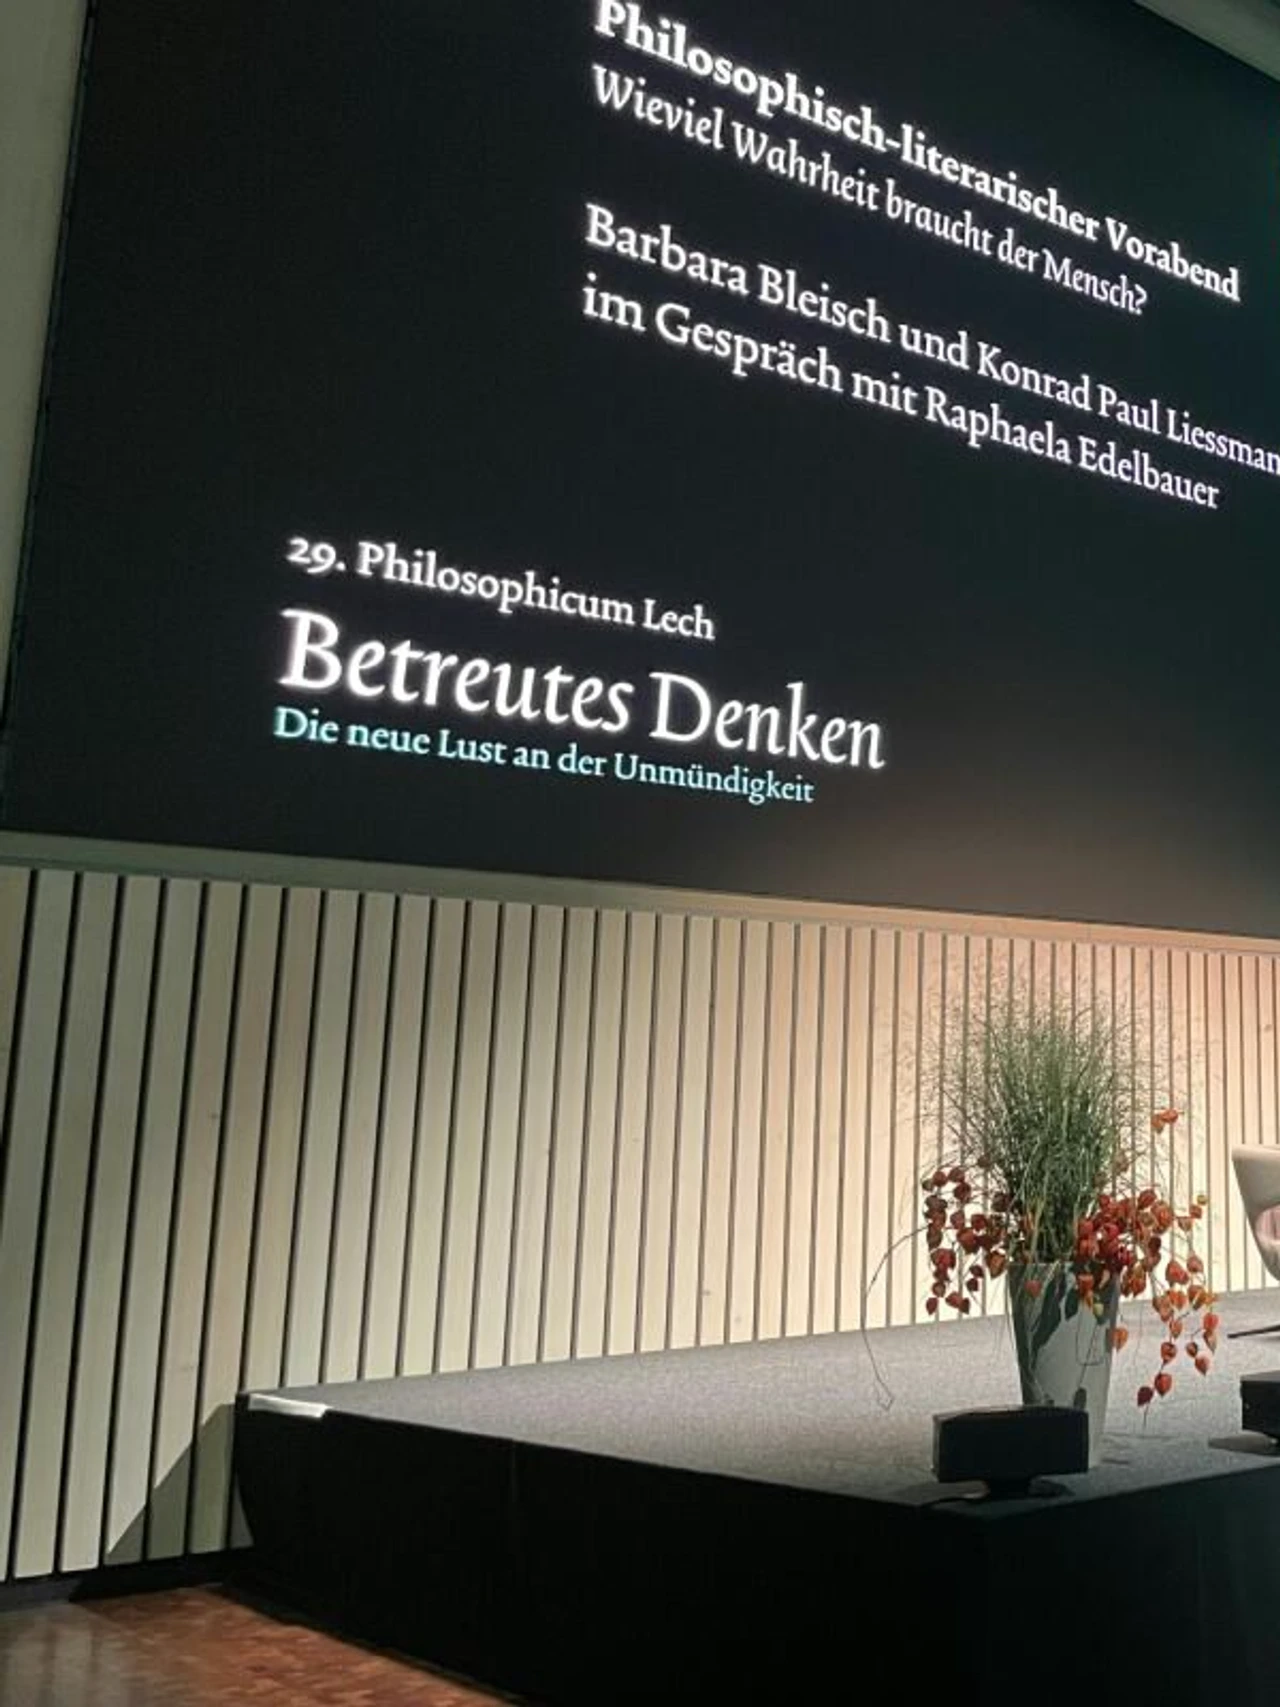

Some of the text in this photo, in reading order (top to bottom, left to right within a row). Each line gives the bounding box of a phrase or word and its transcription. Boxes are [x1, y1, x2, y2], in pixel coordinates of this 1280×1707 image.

[591, 63, 1148, 316] Wieviel Wahrheit braucht der Mensch?
[593, 0, 1241, 303] Philosophisch-literarischer Vorabend
[582, 272, 1220, 510] im Gespräch mit Raphaela Edelbauer
[584, 202, 751, 297] Barbara
[757, 263, 892, 344] Bleisch
[898, 323, 971, 371] und
[976, 341, 1093, 412] Konrad
[1096, 383, 1162, 435] Paul
[277, 608, 886, 770] Betreutes Denken
[286, 536, 716, 642] 29. Philosophicum Lech
[273, 705, 815, 806] Die neue Lust an der Unmündigkeit
